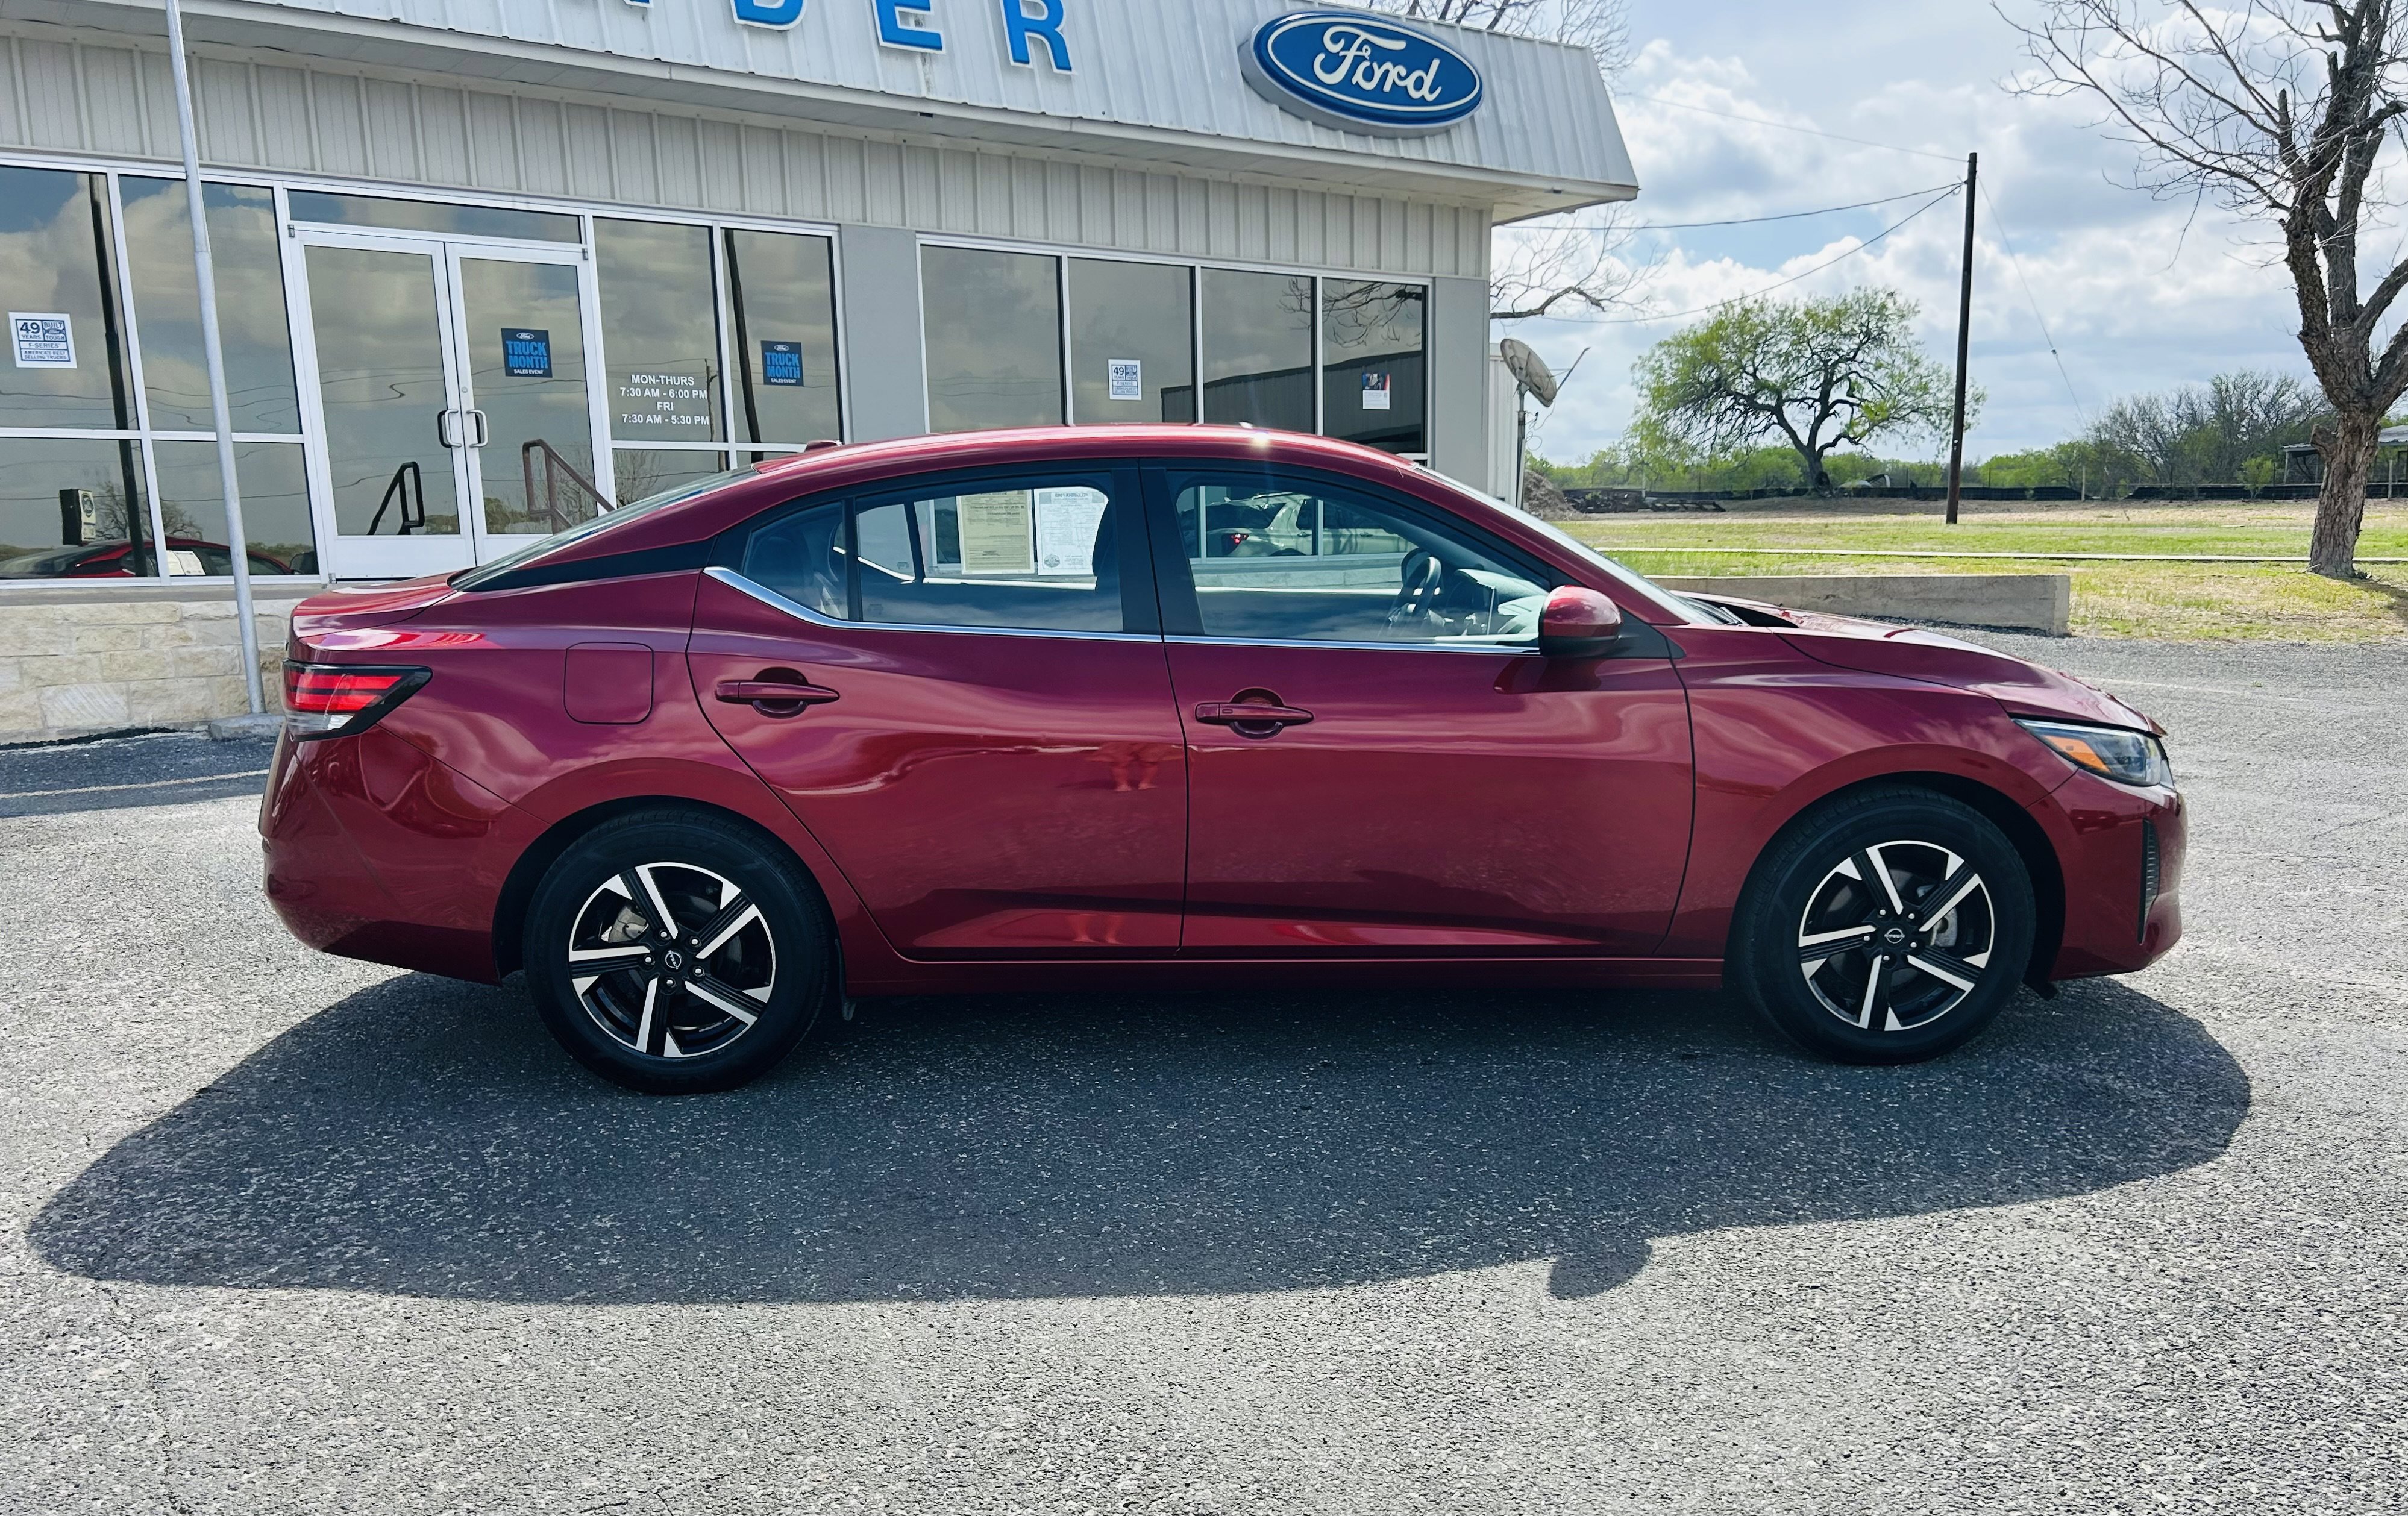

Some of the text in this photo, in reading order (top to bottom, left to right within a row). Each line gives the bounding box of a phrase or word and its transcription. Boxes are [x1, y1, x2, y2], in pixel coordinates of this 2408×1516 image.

[1313, 25, 1443, 102] Ford
[20, 322, 40, 334] 49
[506, 341, 547, 356] TRUCK
[509, 355, 548, 369] MONTH
[765, 352, 800, 366] TRUCK
[767, 365, 801, 378] MONTH
[1113, 366, 1124, 375] 49
[631, 374, 695, 386] MON-THURS
[619, 387, 641, 397] 7:30
[644, 388, 660, 398] AM
[669, 389, 689, 399] 6:00
[692, 389, 707, 399] PM
[656, 401, 674, 411] FRI
[622, 413, 643, 424] 7:30
[645, 415, 662, 424] AM
[671, 415, 691, 425] 5:30
[694, 416, 709, 425] PM
